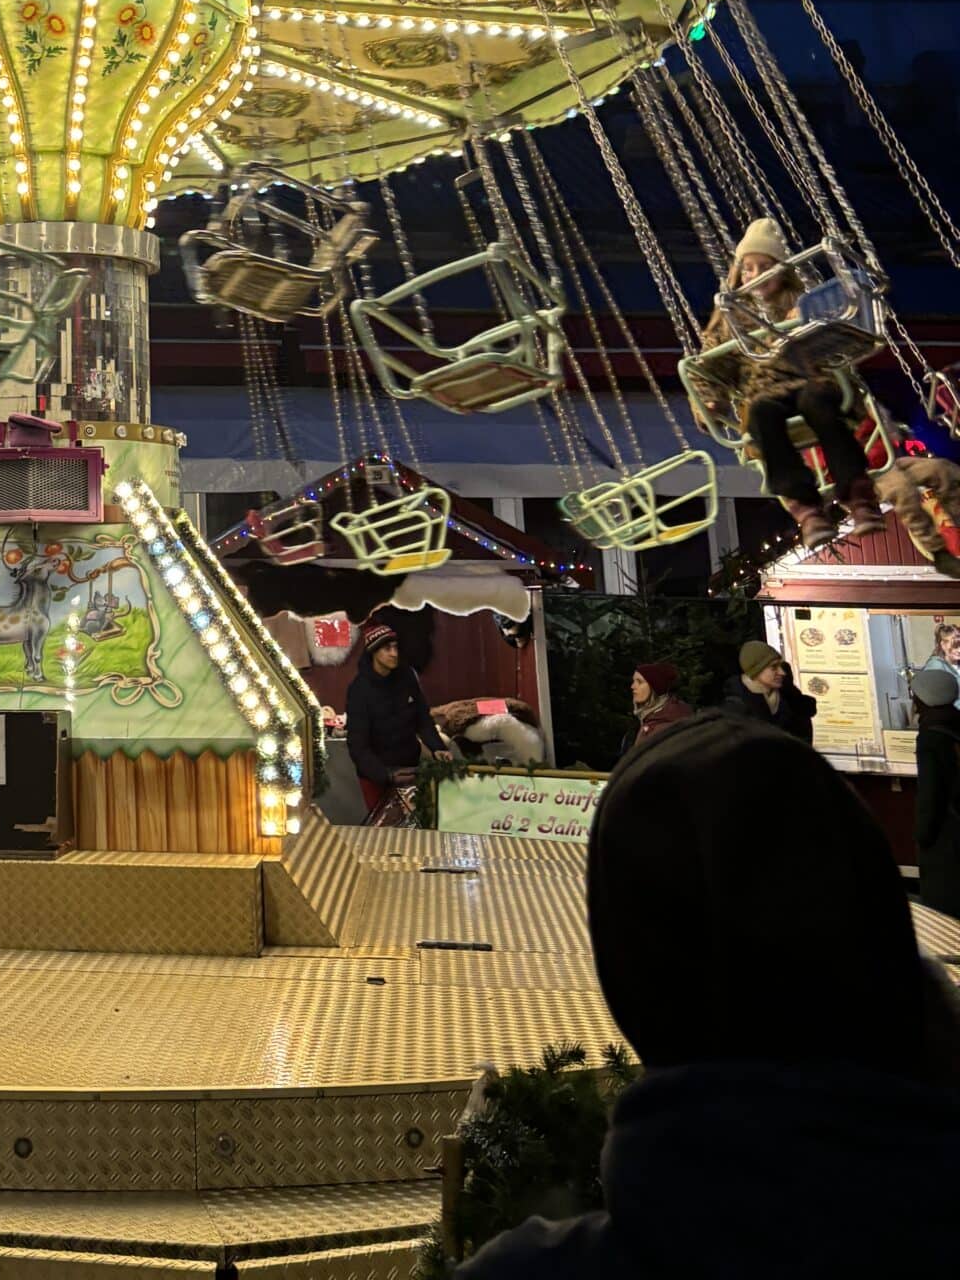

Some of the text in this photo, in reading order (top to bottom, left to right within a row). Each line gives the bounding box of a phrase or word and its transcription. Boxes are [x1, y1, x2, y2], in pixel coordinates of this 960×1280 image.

[498, 783, 548, 804] Hier
[490, 813, 592, 838] ab 2 Jahr
